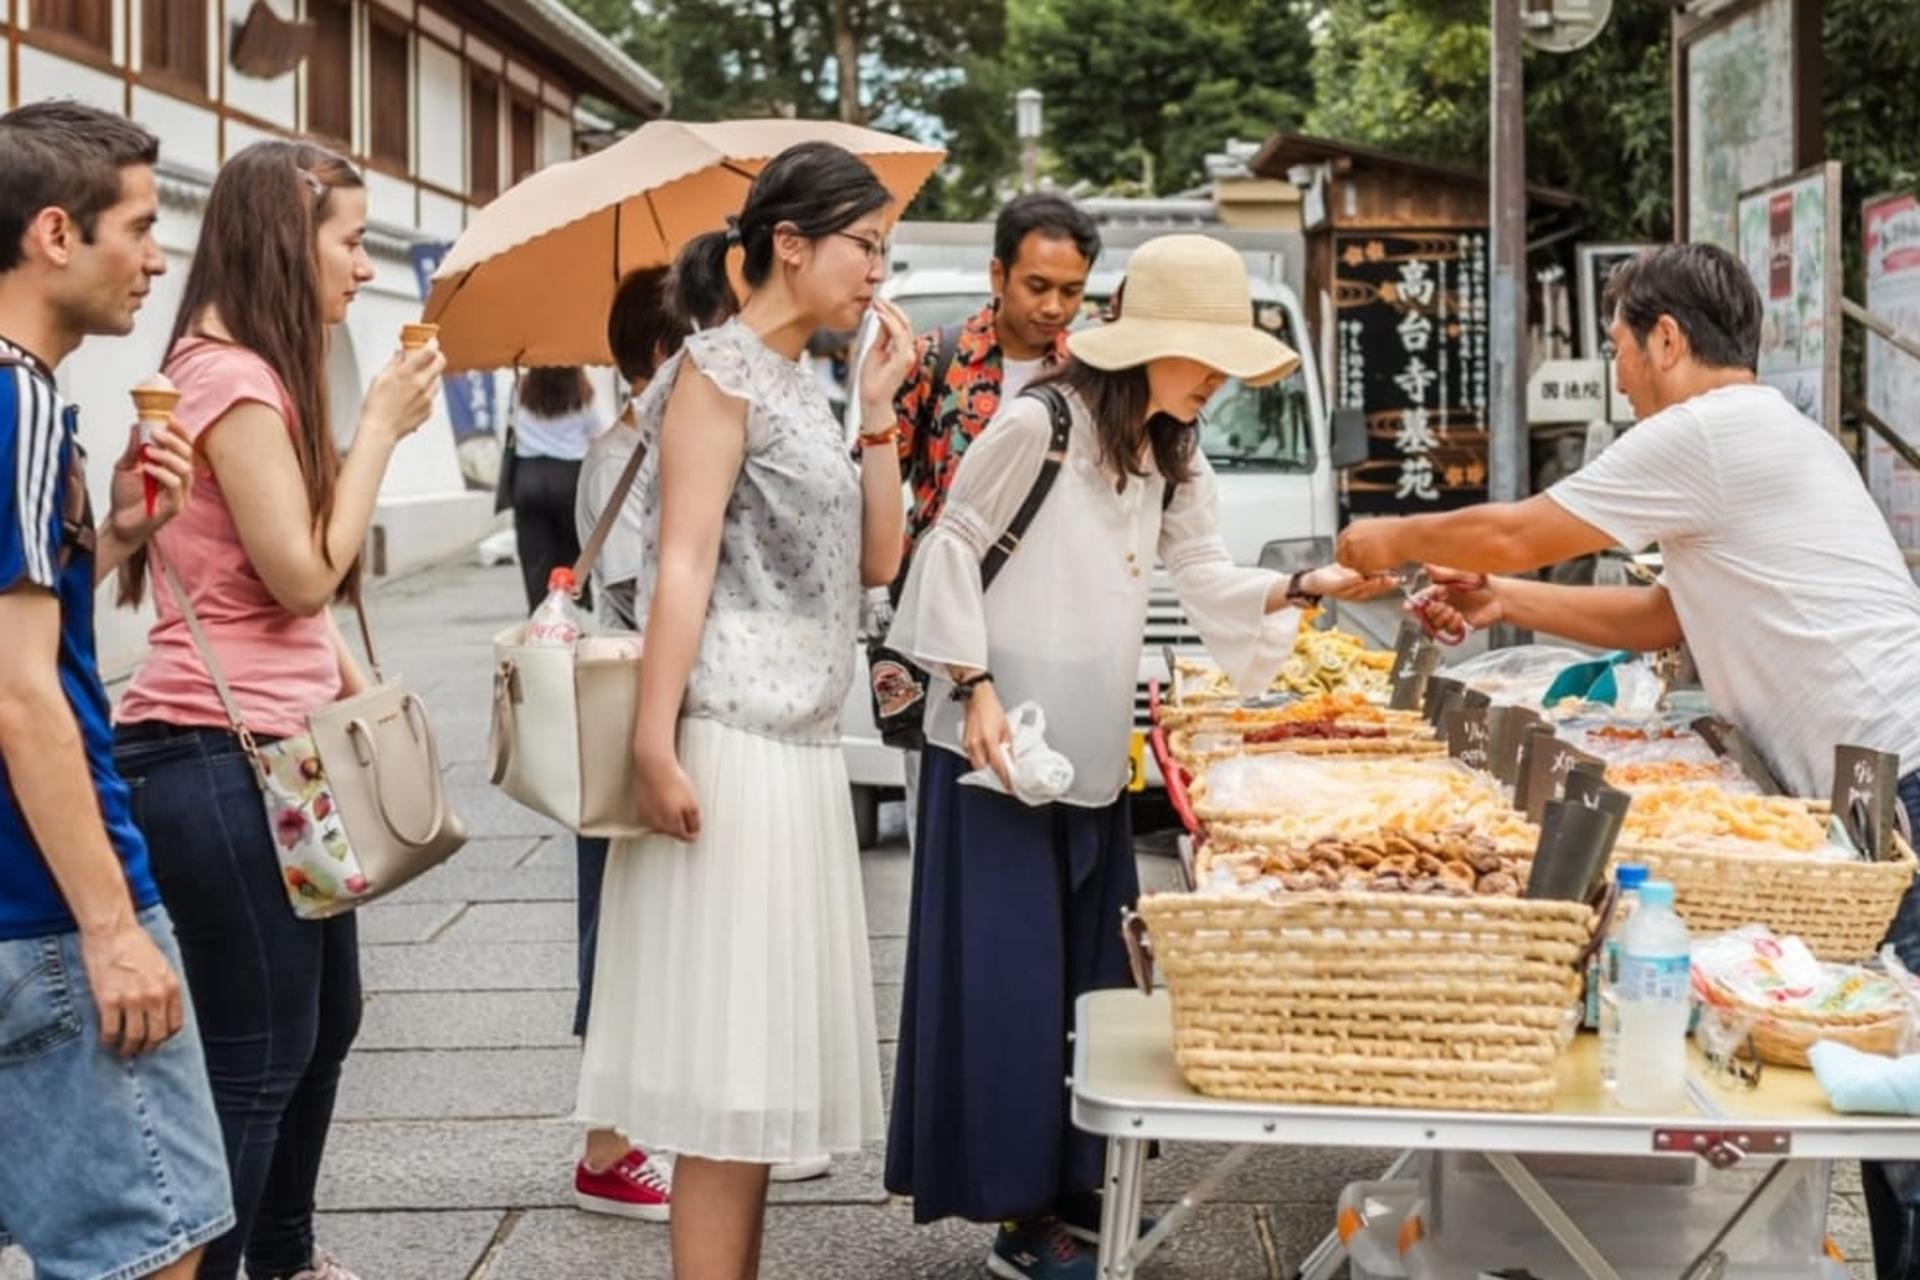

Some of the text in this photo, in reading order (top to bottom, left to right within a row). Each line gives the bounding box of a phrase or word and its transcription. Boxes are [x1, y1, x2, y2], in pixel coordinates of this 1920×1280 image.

[1393, 257, 1440, 500] 高台寺墓苑
